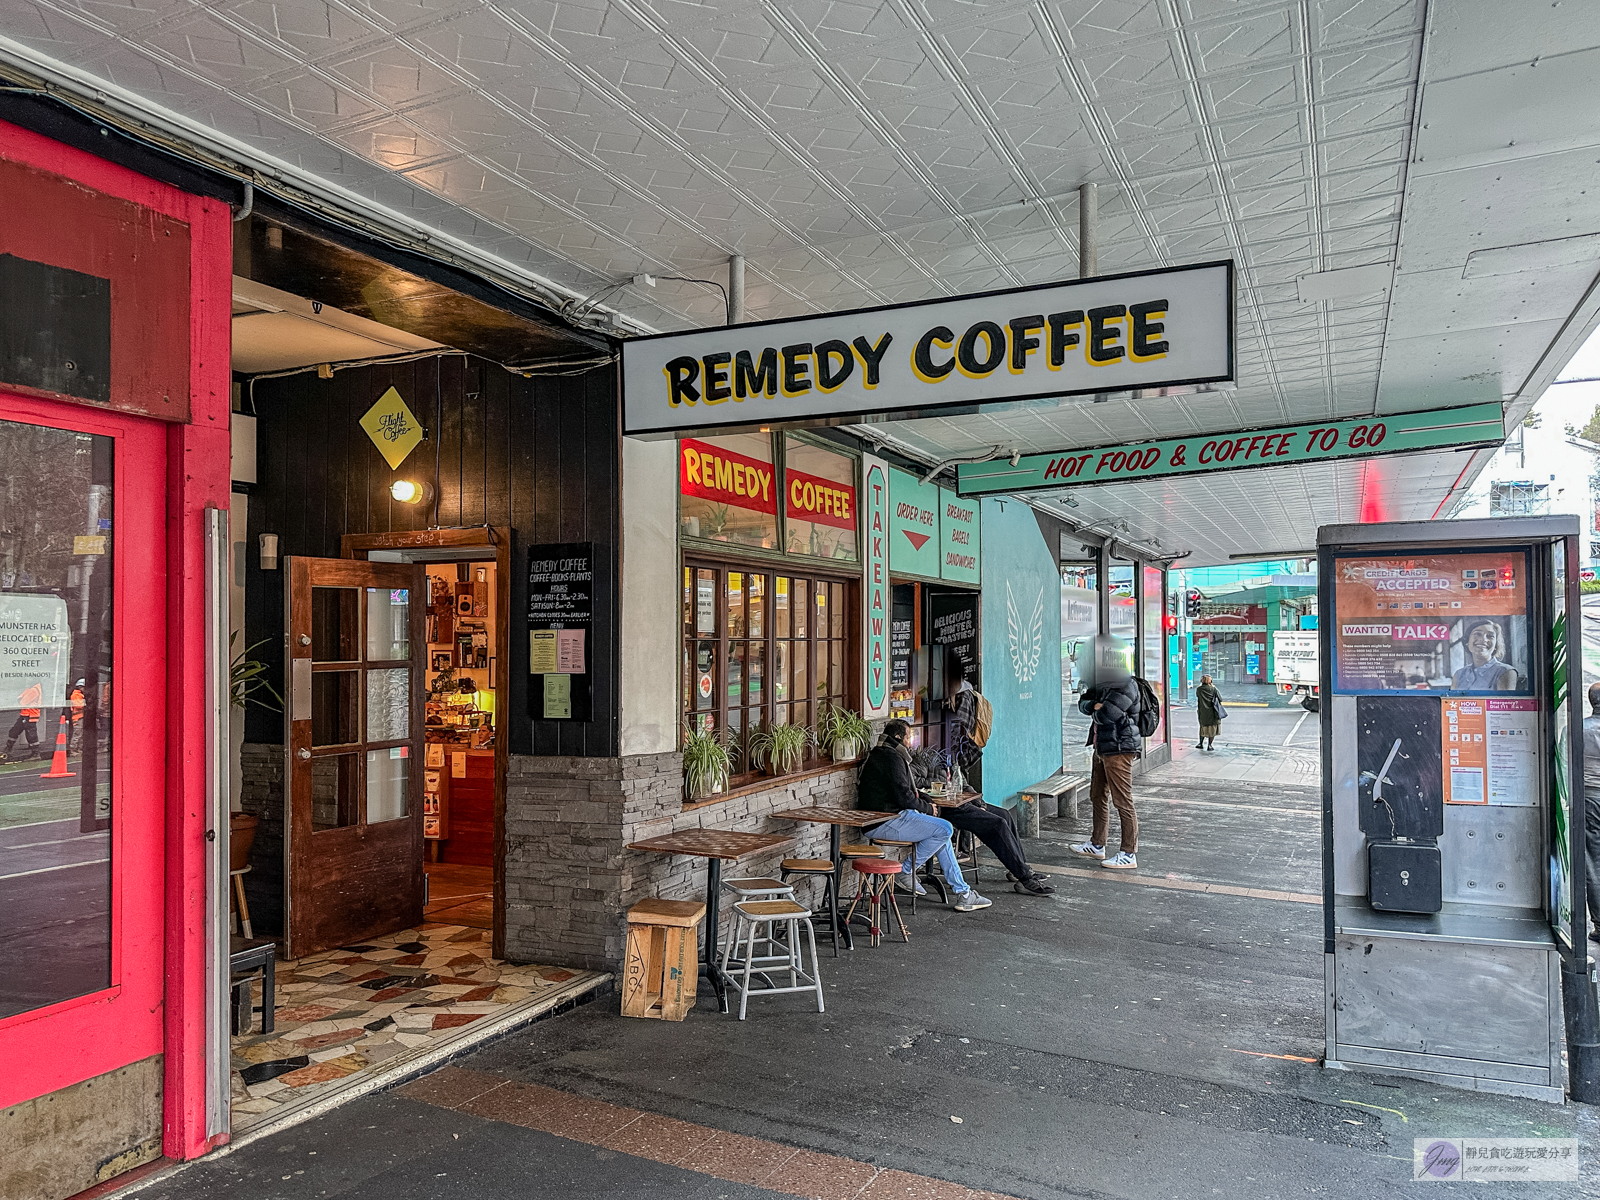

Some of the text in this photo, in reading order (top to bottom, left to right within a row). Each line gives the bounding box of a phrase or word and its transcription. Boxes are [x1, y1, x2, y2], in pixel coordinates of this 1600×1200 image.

[663, 298, 1170, 409] REMEDY COFFEE
[378, 411, 407, 428] Flight
[383, 425, 411, 442] Coffee
[1044, 423, 1386, 480] HOT FOOD & COFFEE TO GO
[683, 448, 850, 519] REMEDY COFFEE
[896, 502, 934, 527] ORDER HERE
[946, 503, 974, 524] BREAKFAST
[397, 536, 413, 547] your
[415, 532, 434, 544] step
[952, 528, 969, 546] BAGELS
[531, 558, 587, 573] REMEDY COFFEE
[945, 552, 976, 570] SANDWICHES
[1399, 569, 1427, 577] CARDS
[550, 584, 568, 593] HOURS
[872, 484, 884, 690] TAKEAWAY
[1376, 579, 1450, 590] ACCEPTED
[0, 622, 57, 631] MUNSTER HAS
[934, 609, 972, 629] DELICIOUS
[940, 620, 973, 636] WINTER
[1344, 625, 1448, 639] WANT TO TALK?
[3, 647, 49, 655] 360 QUEEN
